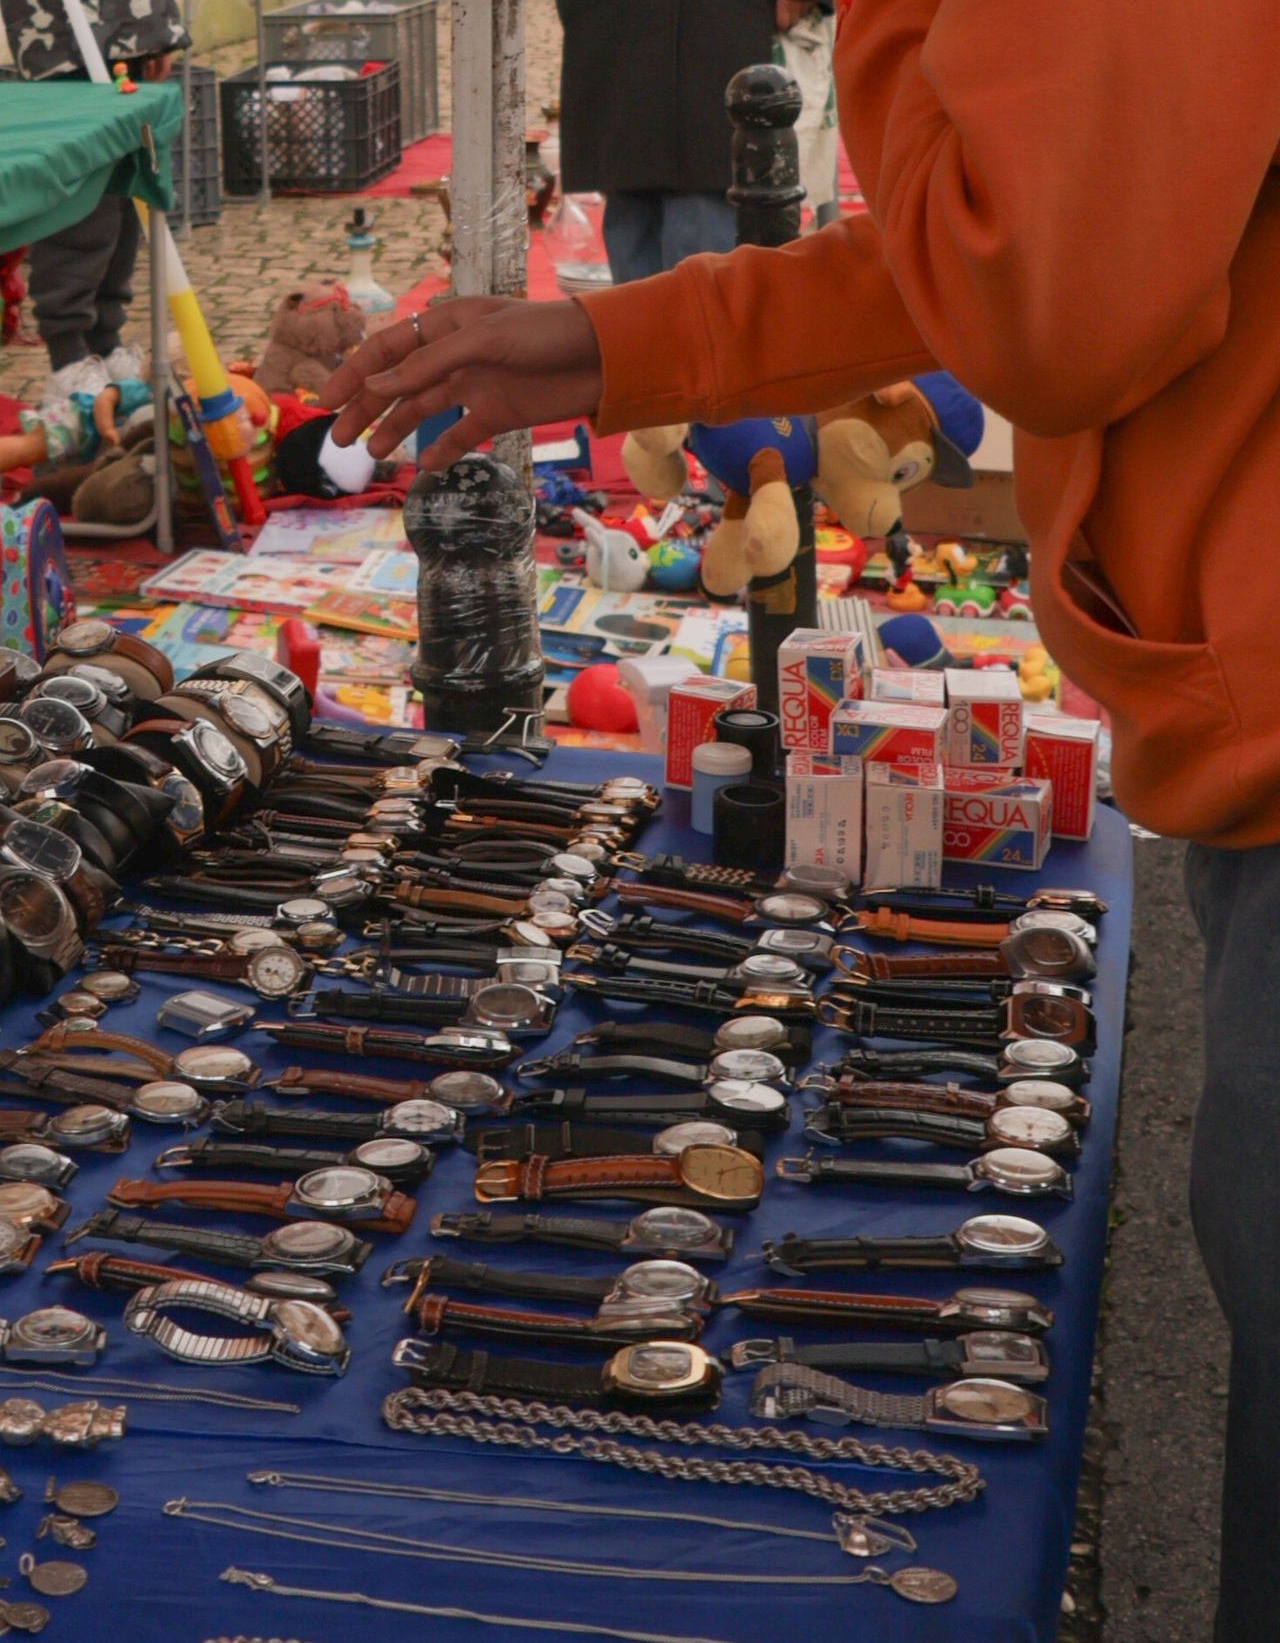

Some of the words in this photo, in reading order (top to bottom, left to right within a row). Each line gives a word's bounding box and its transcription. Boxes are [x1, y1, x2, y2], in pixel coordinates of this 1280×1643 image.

[782, 660, 808, 748] REQUA
[953, 700, 970, 735] 100
[809, 715, 820, 749] COLOR
[1001, 702, 1020, 763] REQUA
[910, 747, 933, 756] FILM
[972, 743, 987, 763] 24
[904, 792, 915, 822] REQUA
[1002, 848, 1022, 863] 24
